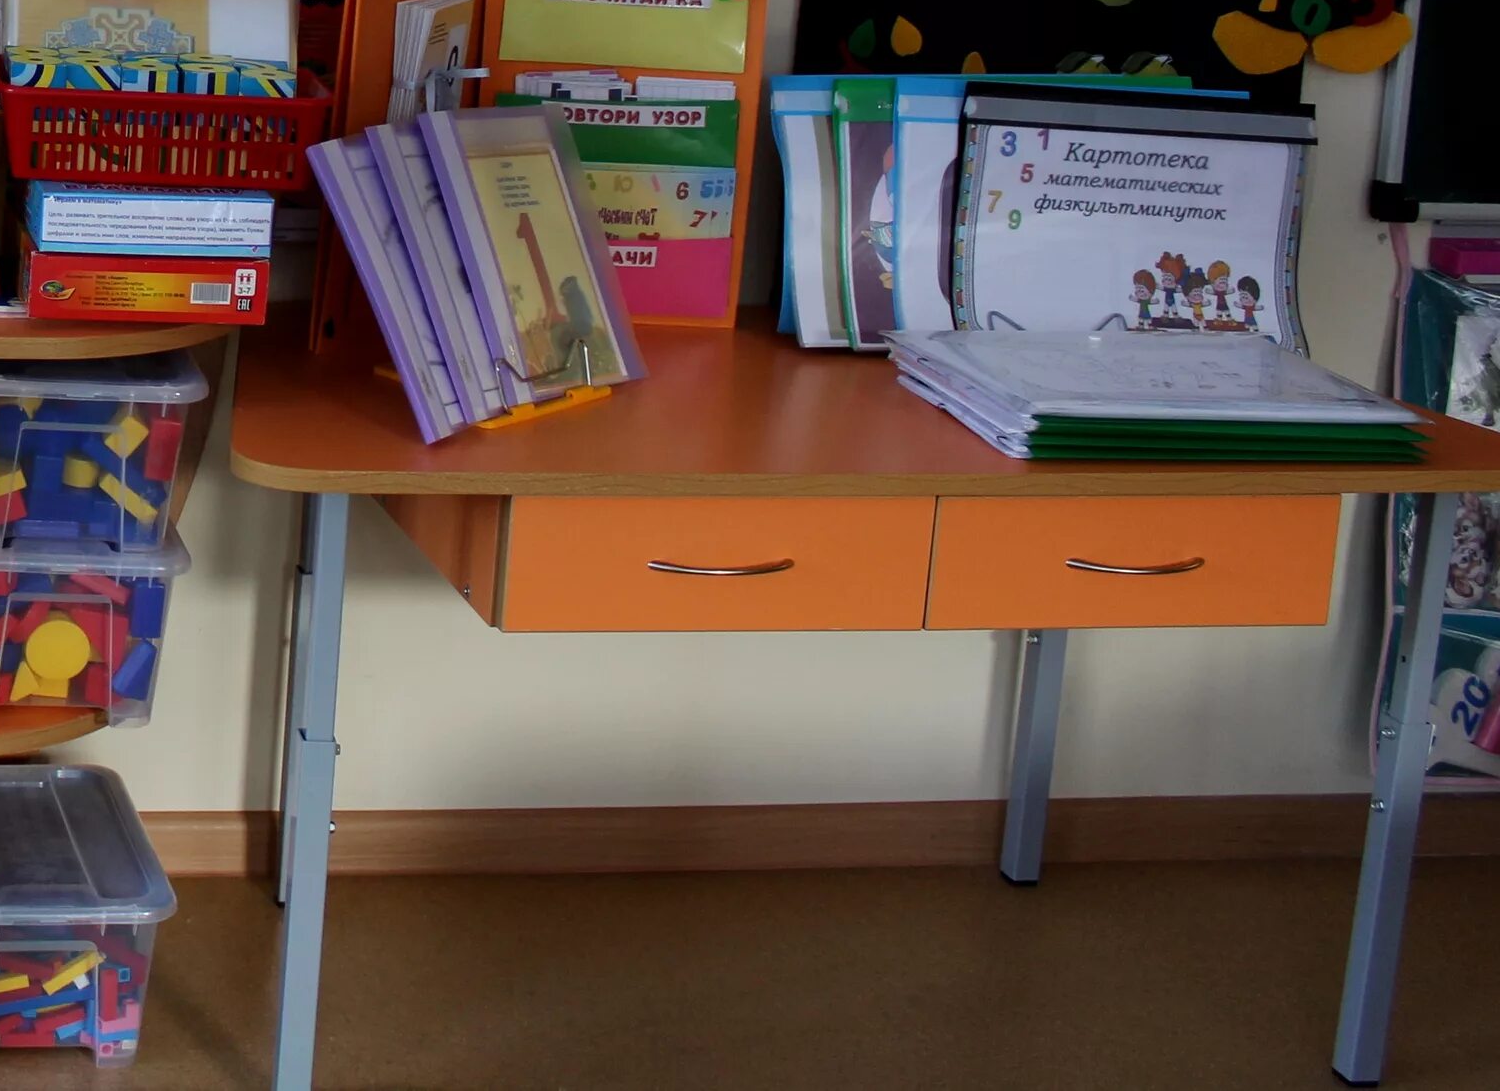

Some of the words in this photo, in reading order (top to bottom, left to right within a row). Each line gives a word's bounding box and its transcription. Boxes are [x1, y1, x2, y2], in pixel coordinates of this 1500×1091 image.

[563, 107, 640, 125] ОВТОРИ
[651, 111, 702, 126] УЗОР
[1000, 130, 1017, 157] 3
[1064, 142, 1209, 170] Картотека
[1020, 163, 1034, 183] 5
[1043, 172, 1224, 196] математических
[676, 181, 689, 200] 6
[987, 189, 1003, 214] 7
[1008, 209, 1022, 230] 9
[1034, 193, 1227, 222] физкультминуток
[612, 250, 653, 265] АЧИ
[1451, 675, 1491, 737] 20
